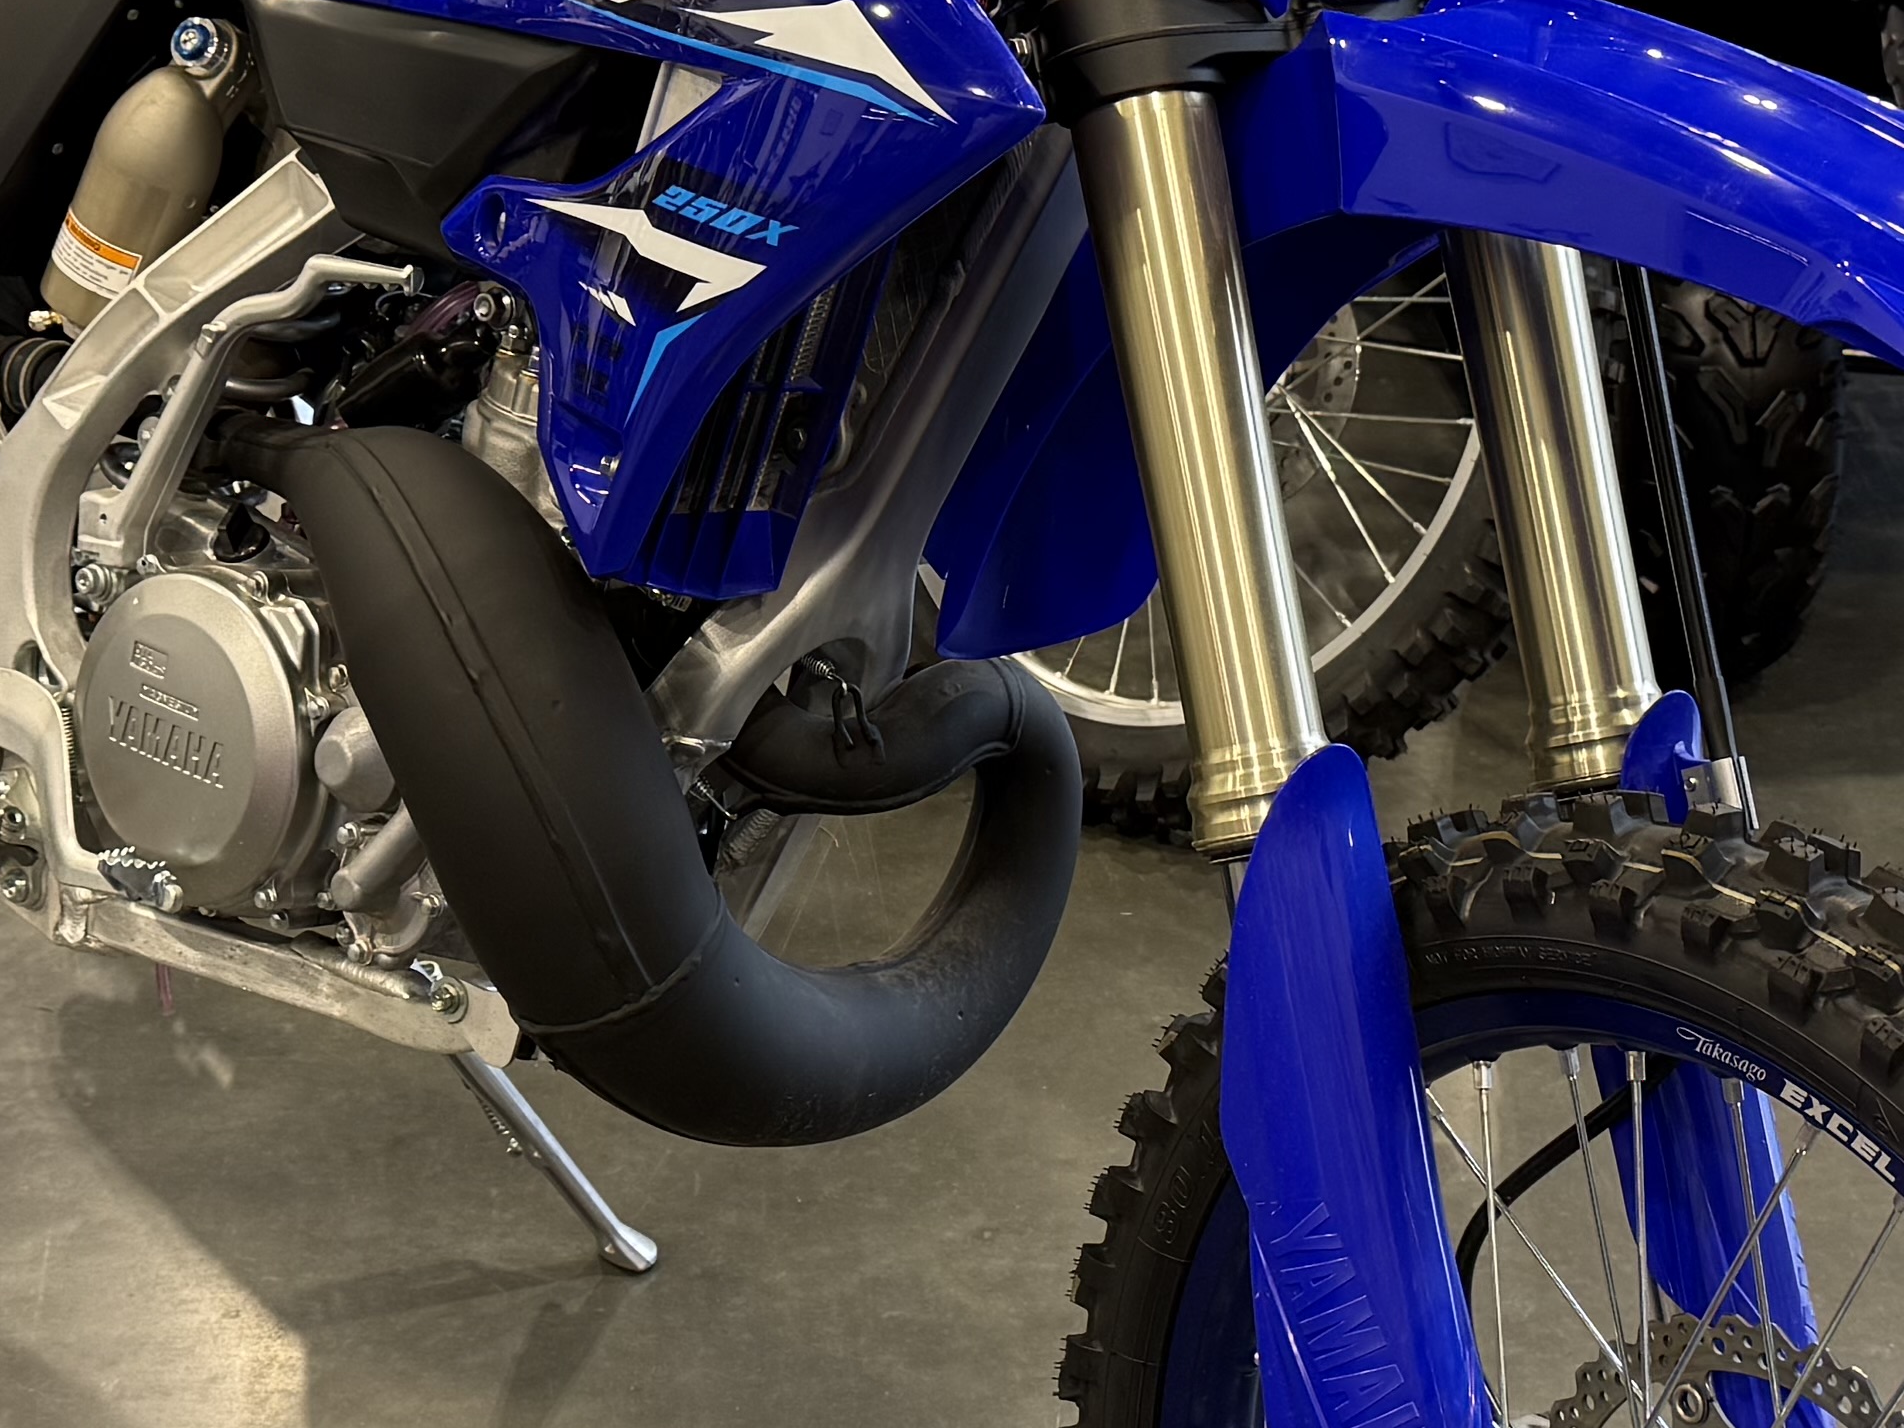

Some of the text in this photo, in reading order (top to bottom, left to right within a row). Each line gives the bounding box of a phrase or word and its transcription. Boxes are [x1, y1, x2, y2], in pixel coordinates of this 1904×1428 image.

[652, 184, 800, 246] 250X
[108, 696, 224, 789] YAMAHA
[1676, 1026, 1767, 1083] Takasago
[1780, 1078, 1896, 1183] EXCEL
